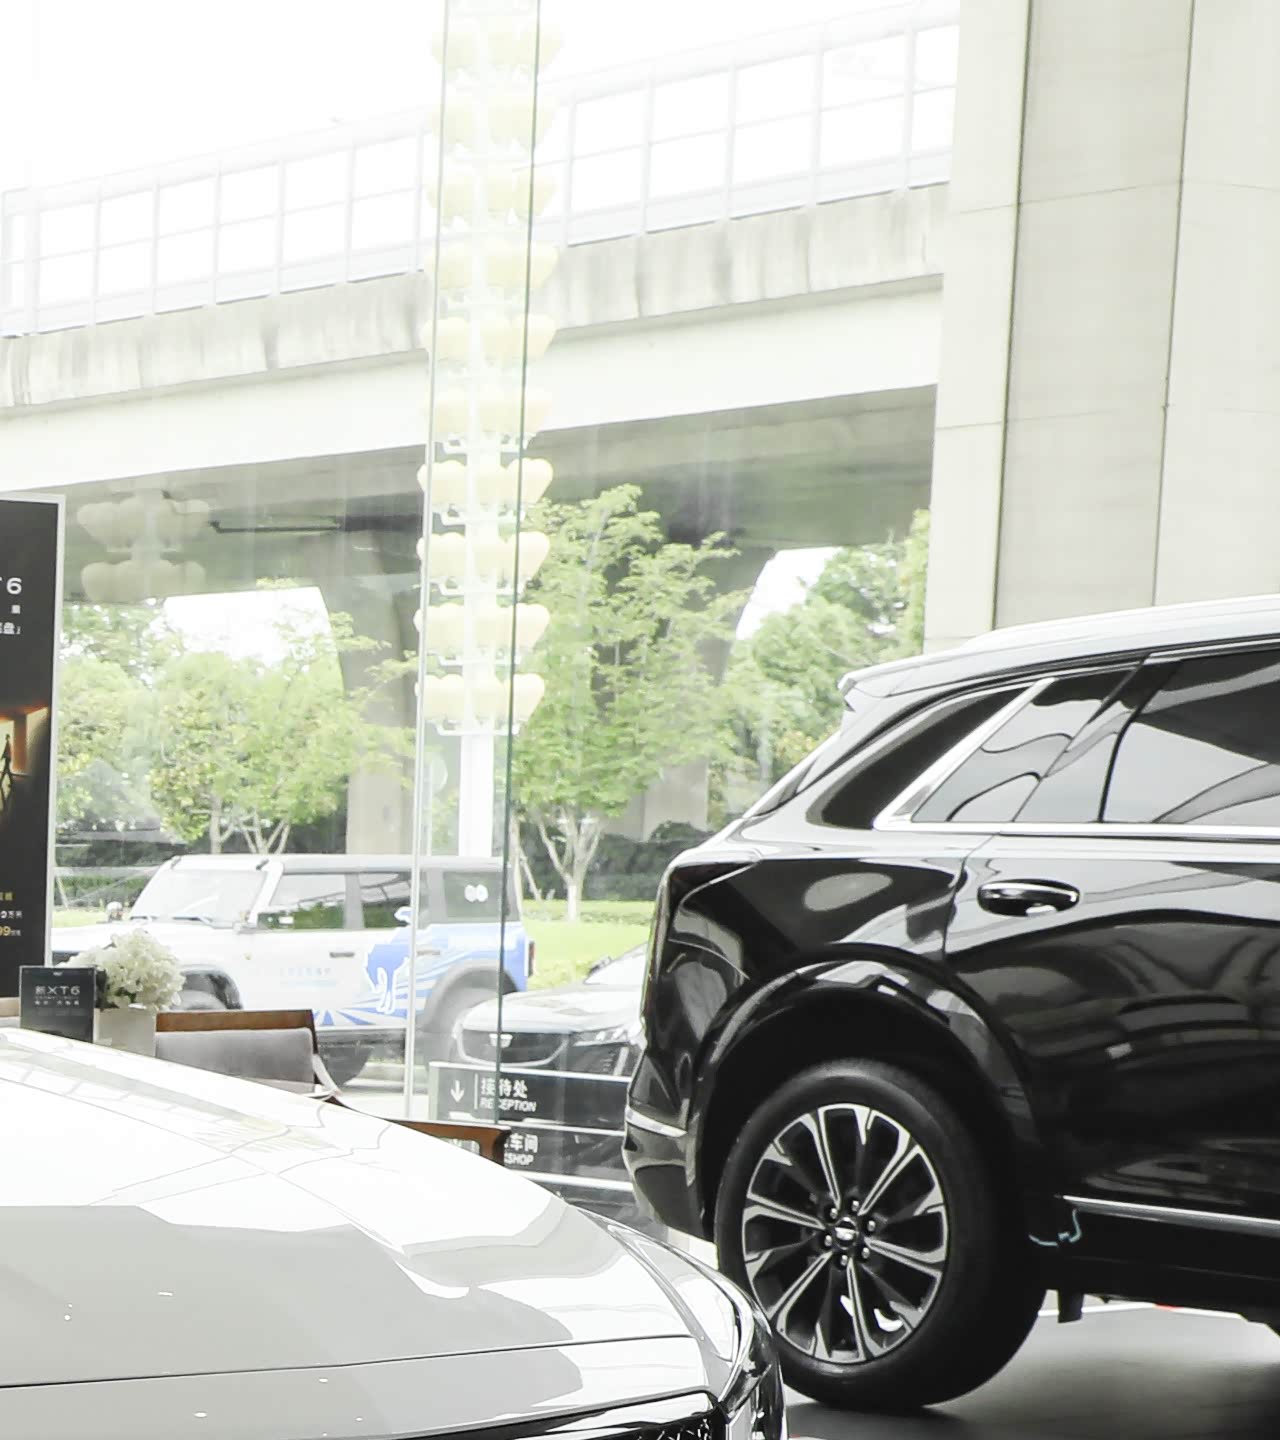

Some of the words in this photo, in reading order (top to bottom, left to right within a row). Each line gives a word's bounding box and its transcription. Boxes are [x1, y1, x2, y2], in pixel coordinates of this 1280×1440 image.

[481, 1077, 528, 1099] 接待处
[504, 1133, 539, 1154] 车间
